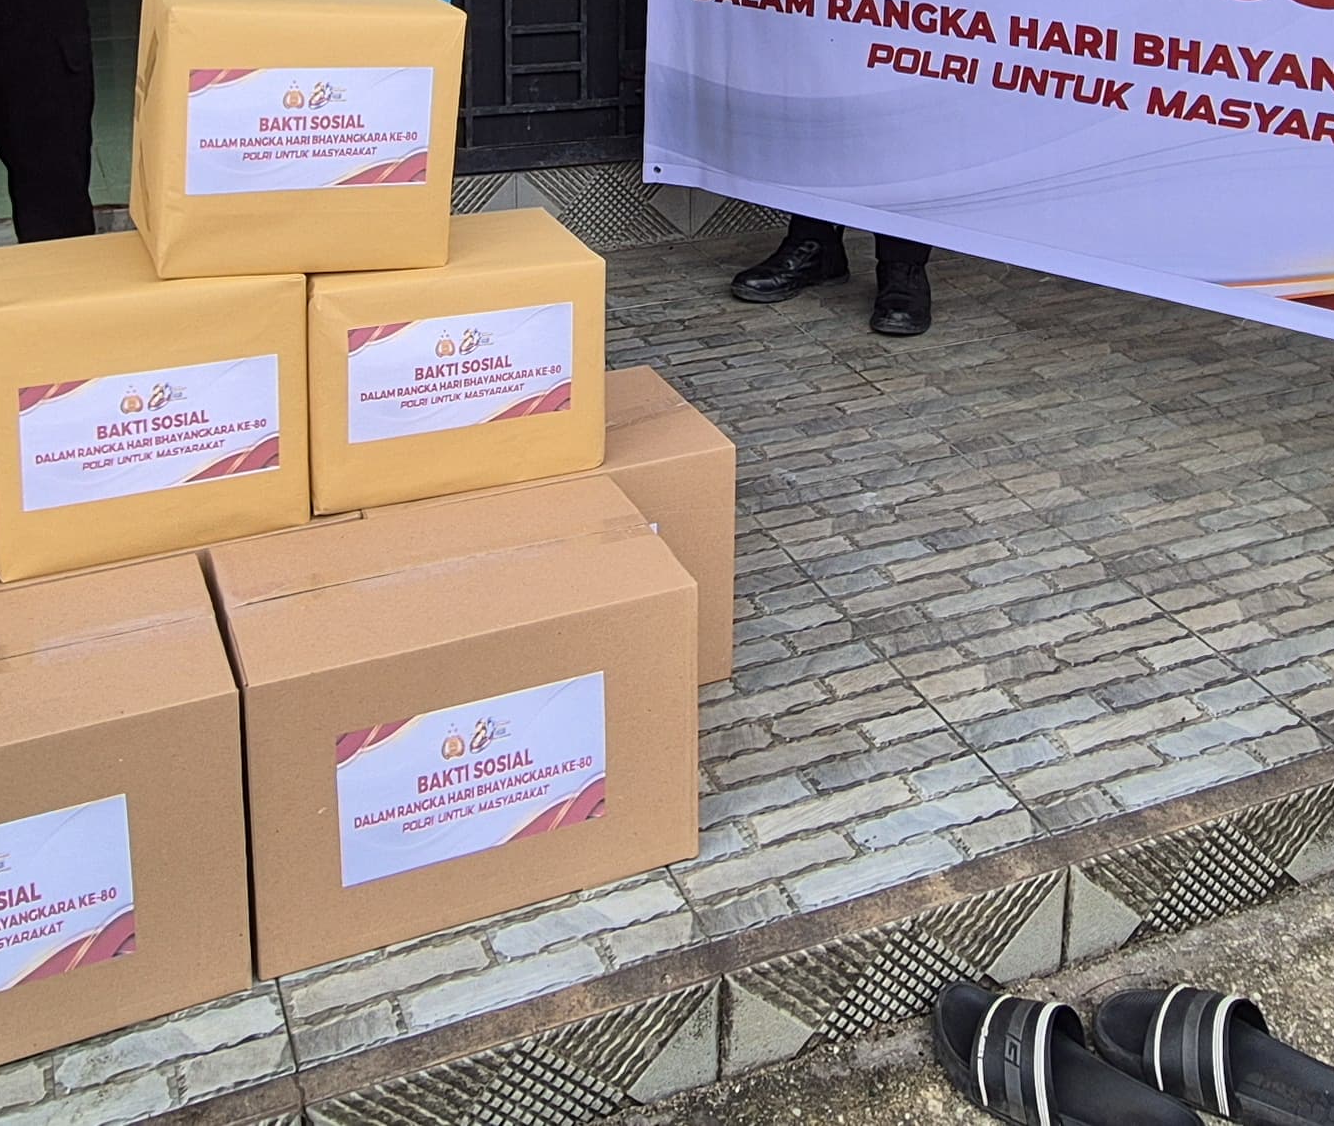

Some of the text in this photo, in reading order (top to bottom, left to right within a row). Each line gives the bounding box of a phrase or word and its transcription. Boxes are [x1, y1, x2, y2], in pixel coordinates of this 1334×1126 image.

[1009, 16, 1117, 61] HARI
[867, 43, 979, 84] POLRI
[992, 61, 1134, 110] UNTUK
[259, 114, 365, 132] BAKTI SOSIAL
[199, 131, 418, 149] DALAM RANGKA HARI BHAYANGKARA KE-80
[242, 146, 378, 161] POLRI UNTUK MASYARAKAT
[360, 365, 562, 402] DALAM RANGKA HARI BHAYANGKARA KE-80
[414, 355, 512, 381] BAKTI SOSIAL
[400, 383, 525, 410] POLRI UNTUK MASYARAKAT
[96, 409, 209, 440] BAKTI SOSIAL
[35, 449, 76, 465] DALAM
[77, 443, 125, 458] RANGKA
[126, 438, 153, 451] HARI
[154, 425, 236, 446] BHAYANGKARA
[82, 439, 225, 471] POLRI UNTUK MASYARAKAT
[417, 748, 534, 795] BAKTI SOSIAL
[354, 755, 593, 830] DALAM RANGKA HARI BHAYANGKARA KE-80
[402, 784, 551, 834] POLRI UNTUK MASYARAKAT
[78, 886, 117, 909] KE-80
